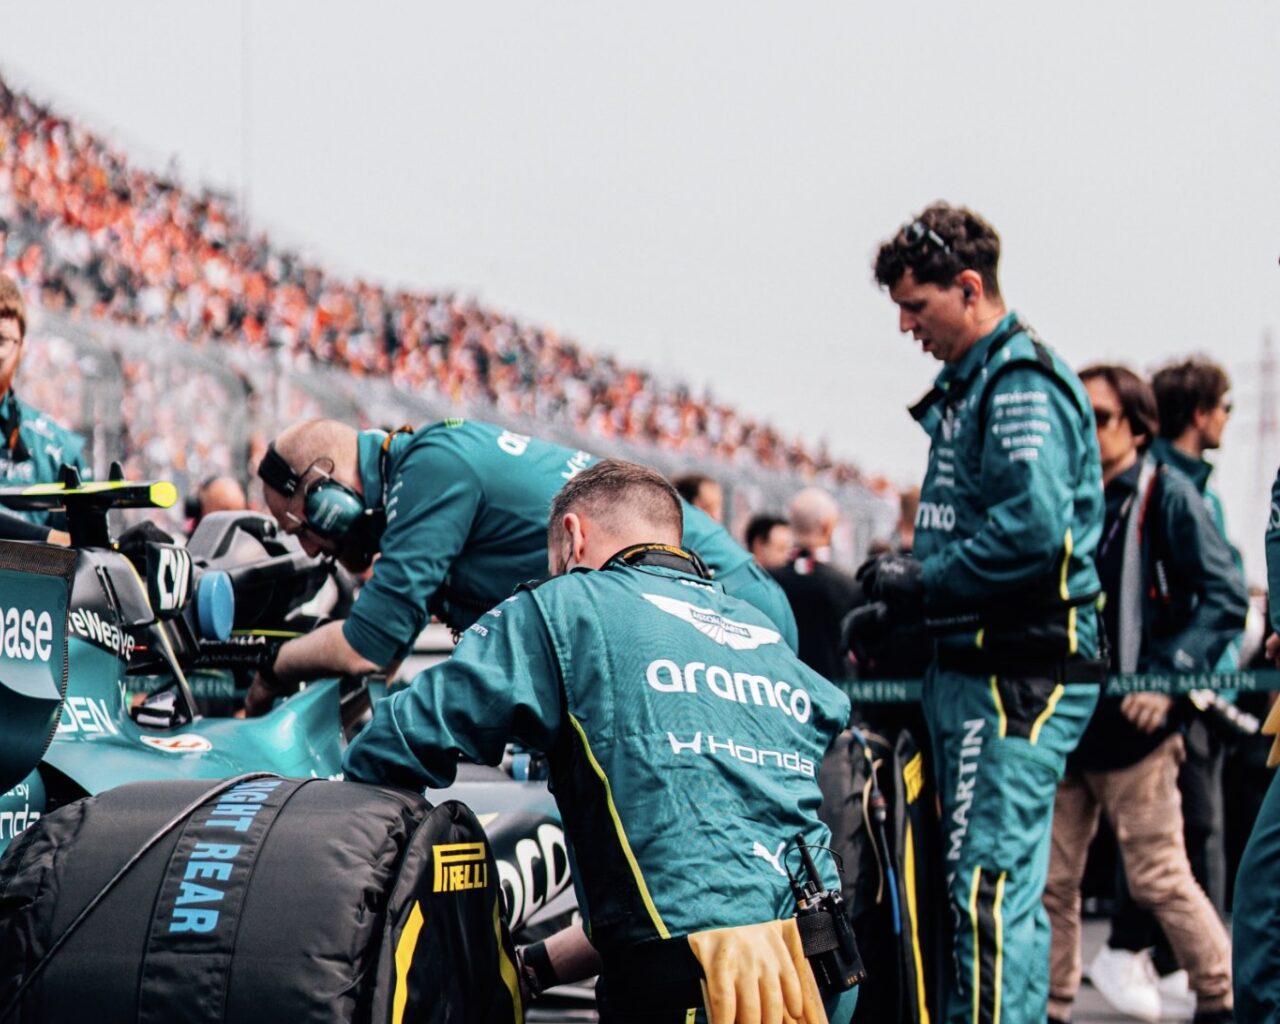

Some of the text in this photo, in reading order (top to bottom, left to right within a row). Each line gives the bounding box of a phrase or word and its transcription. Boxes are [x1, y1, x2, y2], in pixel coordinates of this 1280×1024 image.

[646, 659, 811, 724] aramco
[708, 735, 814, 777] Honda
[949, 718, 985, 861] MARTIN
[169, 843, 241, 935] REAR
[432, 842, 487, 892] PIRELLI
